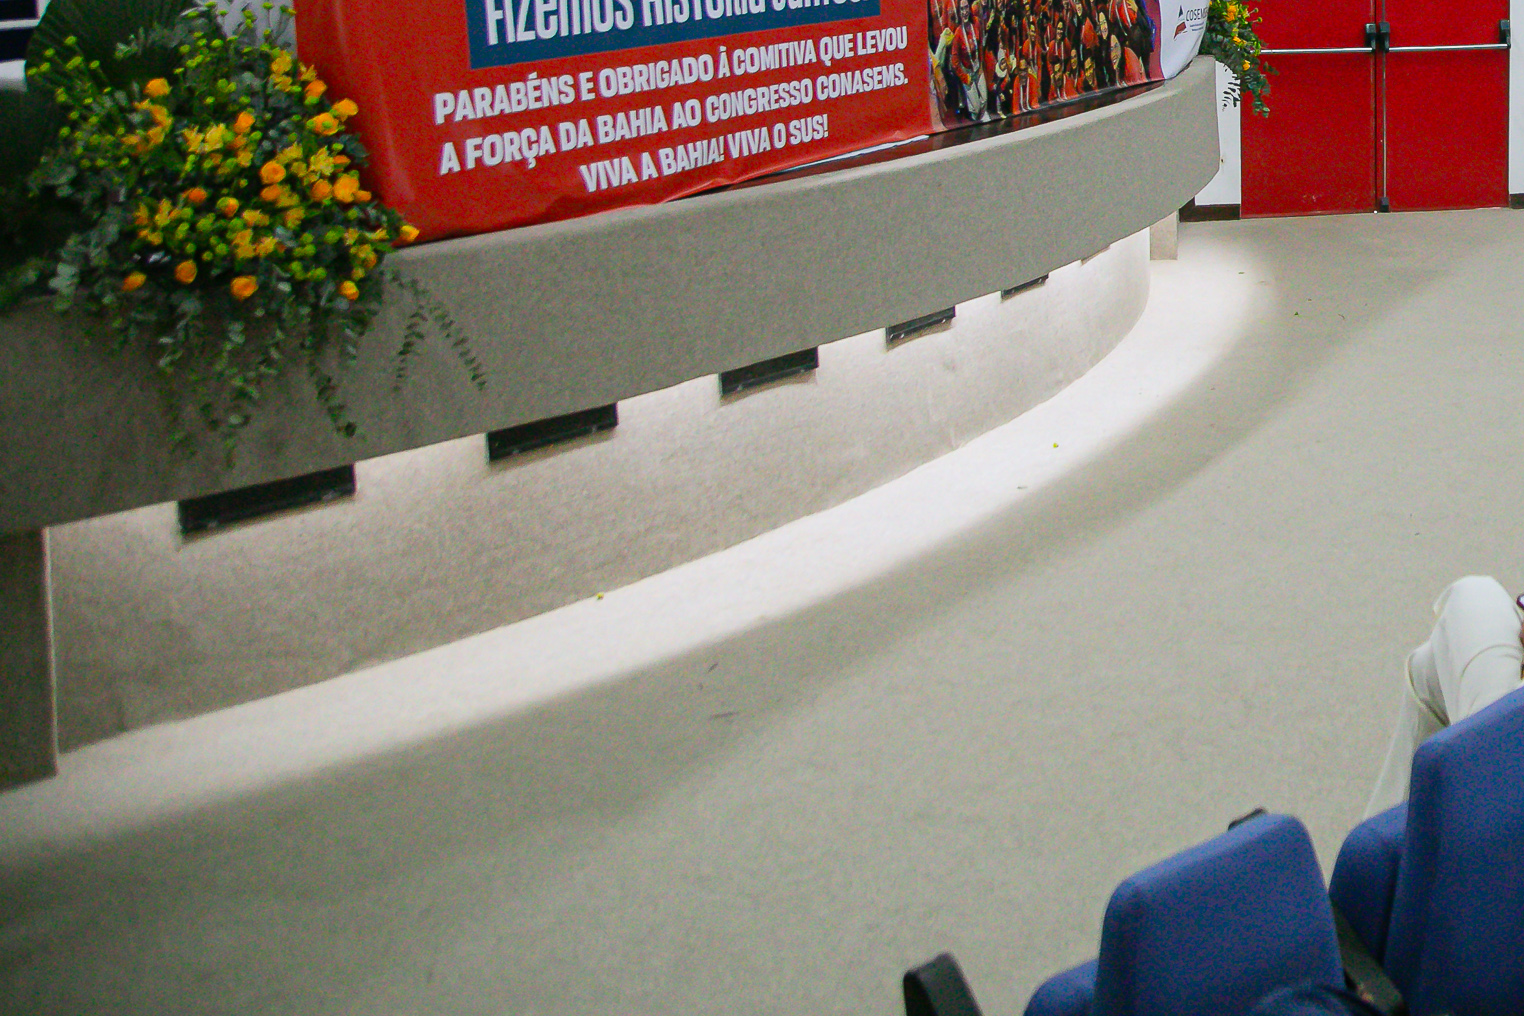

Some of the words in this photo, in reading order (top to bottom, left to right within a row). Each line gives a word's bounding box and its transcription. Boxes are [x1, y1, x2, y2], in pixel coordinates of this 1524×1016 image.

[433, 71, 575, 125] PARABÉNS
[579, 71, 596, 101] E
[599, 53, 714, 99] OBRIGADO
[717, 46, 731, 78] À
[732, 39, 817, 76] COMITIVA
[819, 33, 854, 67] QUE
[856, 26, 908, 56] LEVOU
[438, 141, 461, 176] A
[464, 125, 556, 169] FORÇA
[558, 118, 594, 152] DA
[596, 105, 668, 145] BAHIA
[671, 98, 702, 129] AO
[705, 78, 813, 123] CONGRESSO
[816, 62, 908, 101] CONASEMS.
[579, 156, 638, 193] VIVA
[641, 152, 658, 181] A
[658, 135, 725, 177] BAHIA!
[727, 128, 771, 159] VIVA
[773, 122, 787, 149] O
[788, 113, 829, 146] SUS!
